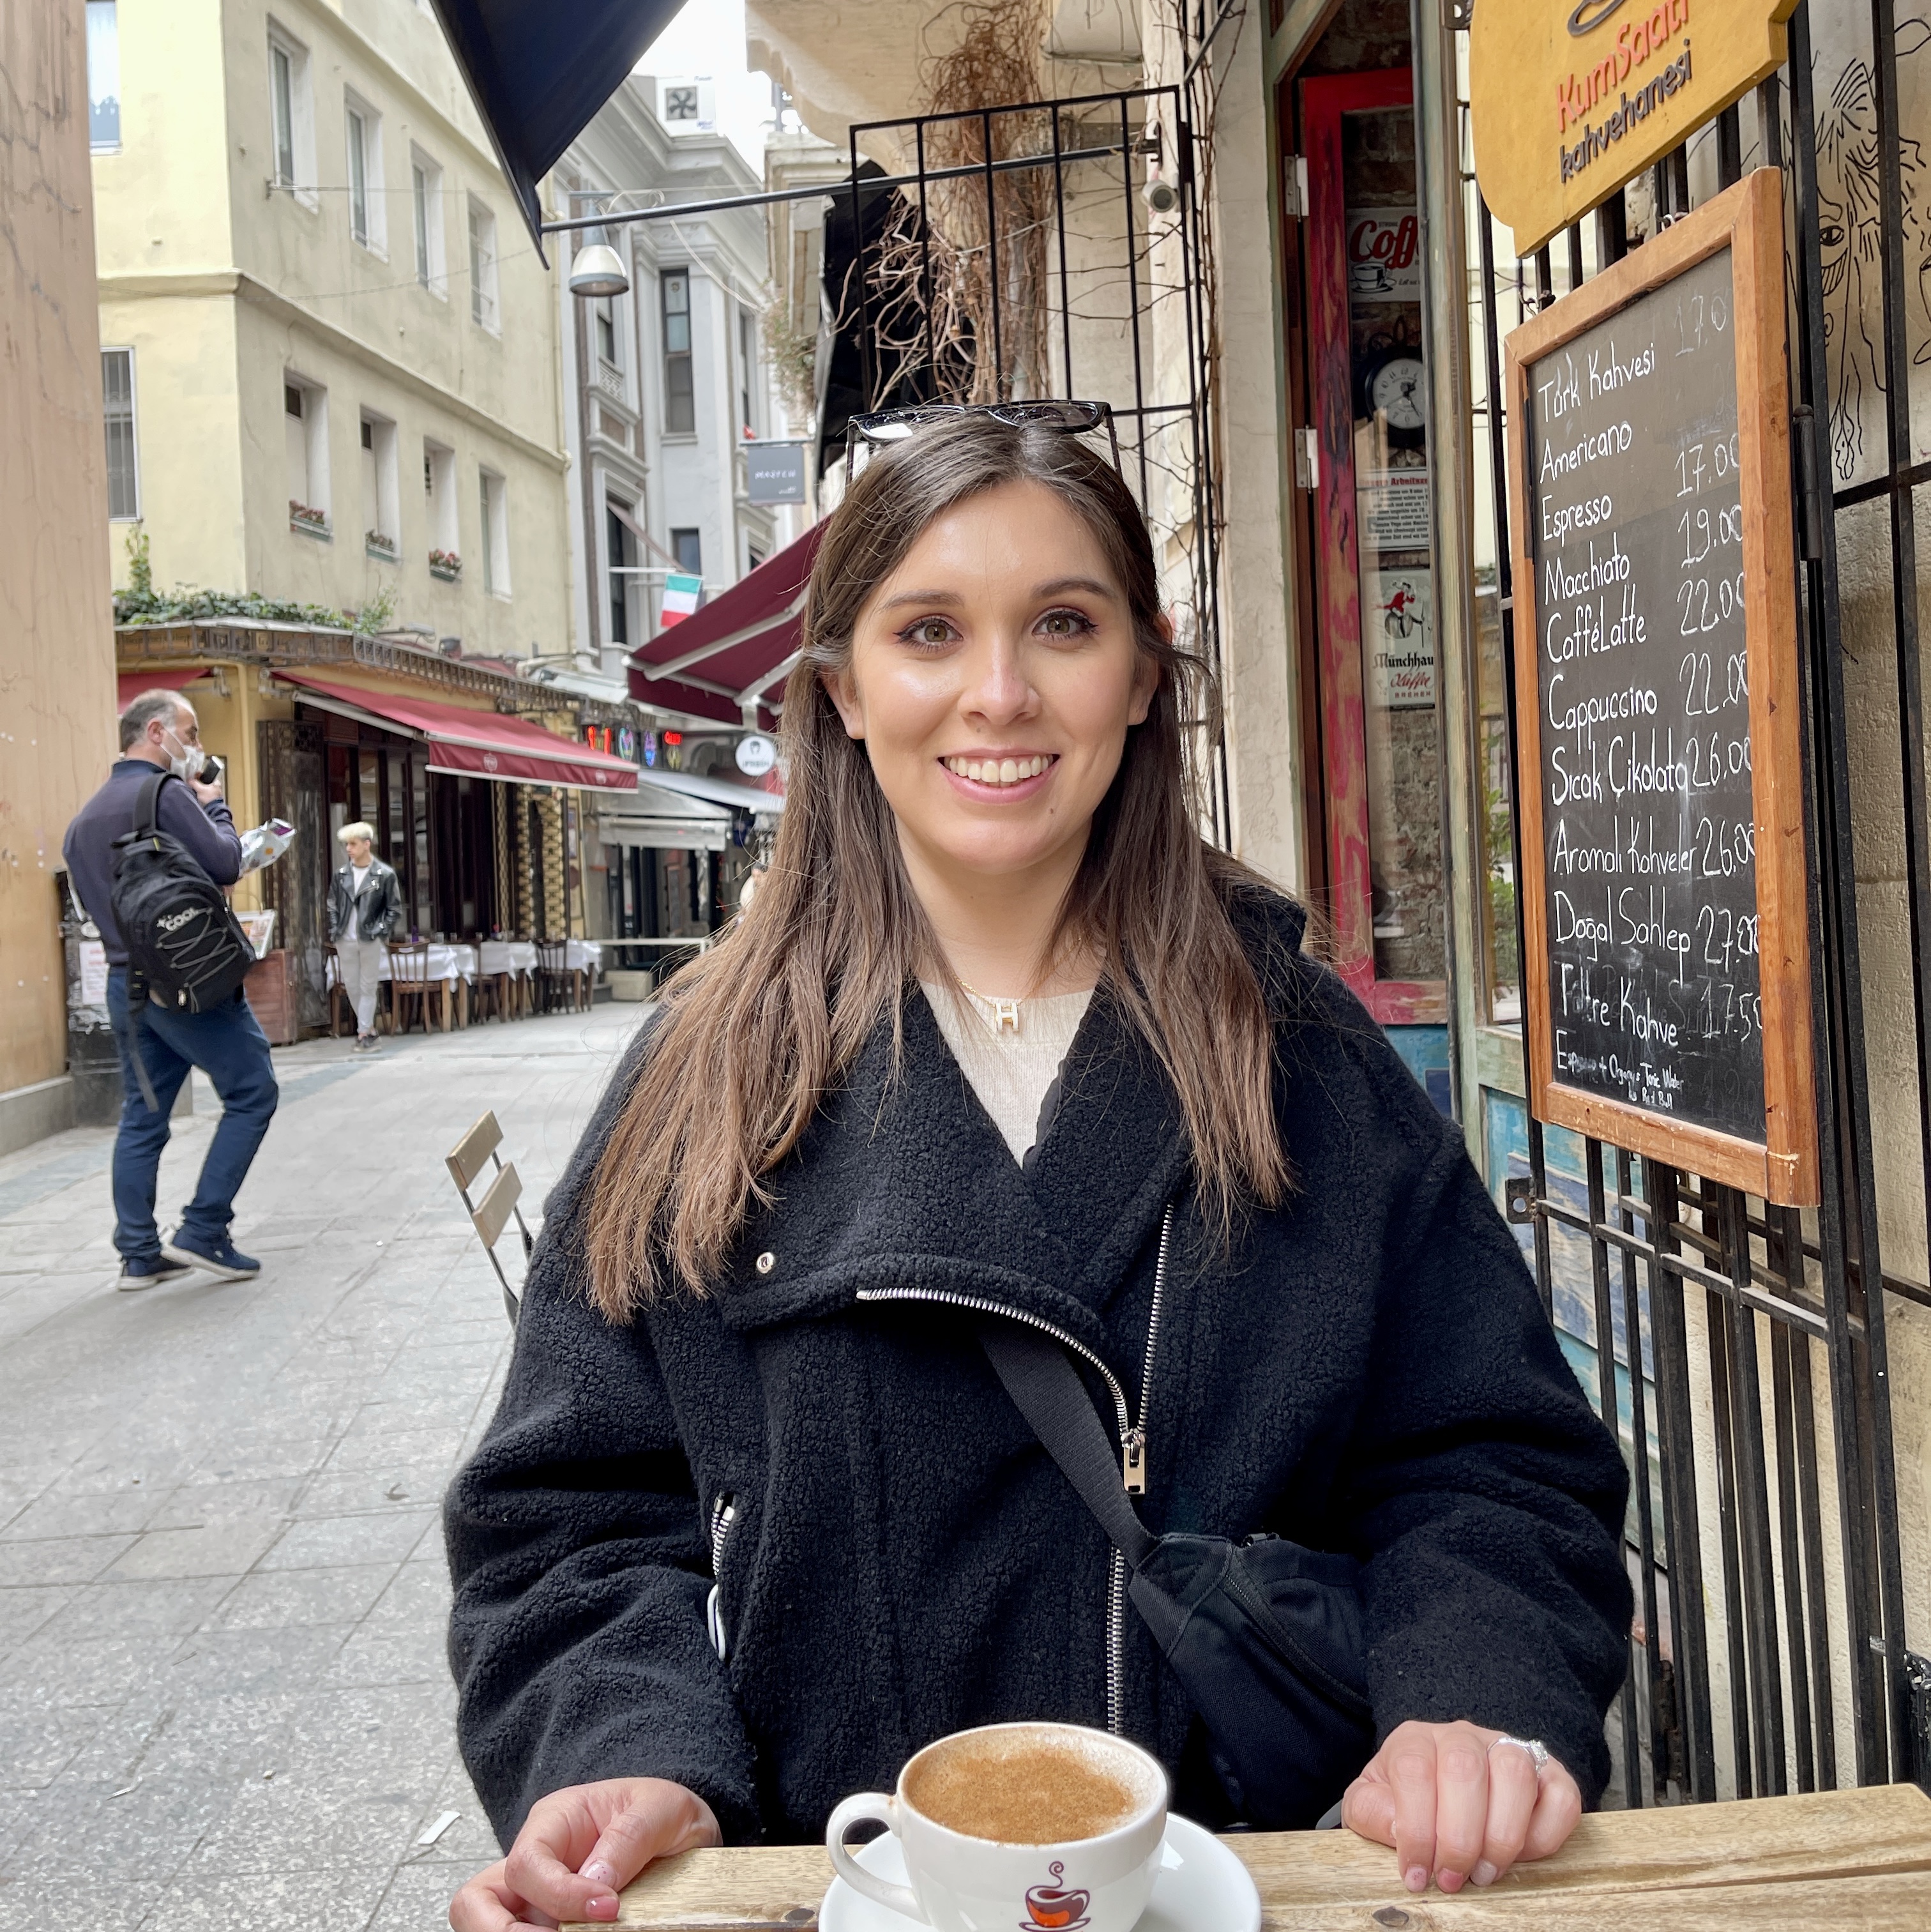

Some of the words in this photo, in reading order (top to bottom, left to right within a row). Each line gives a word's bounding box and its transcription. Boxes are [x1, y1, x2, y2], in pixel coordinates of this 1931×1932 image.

[1560, 38, 1692, 183] kahvehanesi
[1588, 341, 1655, 400] Kahvesi
[1540, 423, 1632, 484] Americano
[1542, 494, 1612, 547] Espresso
[1545, 531, 1630, 605] Macchiato
[1549, 674, 1658, 755] Cappuccino
[1619, 885, 1691, 990] Sahlep
[1620, 976, 1679, 1047] Kahve
